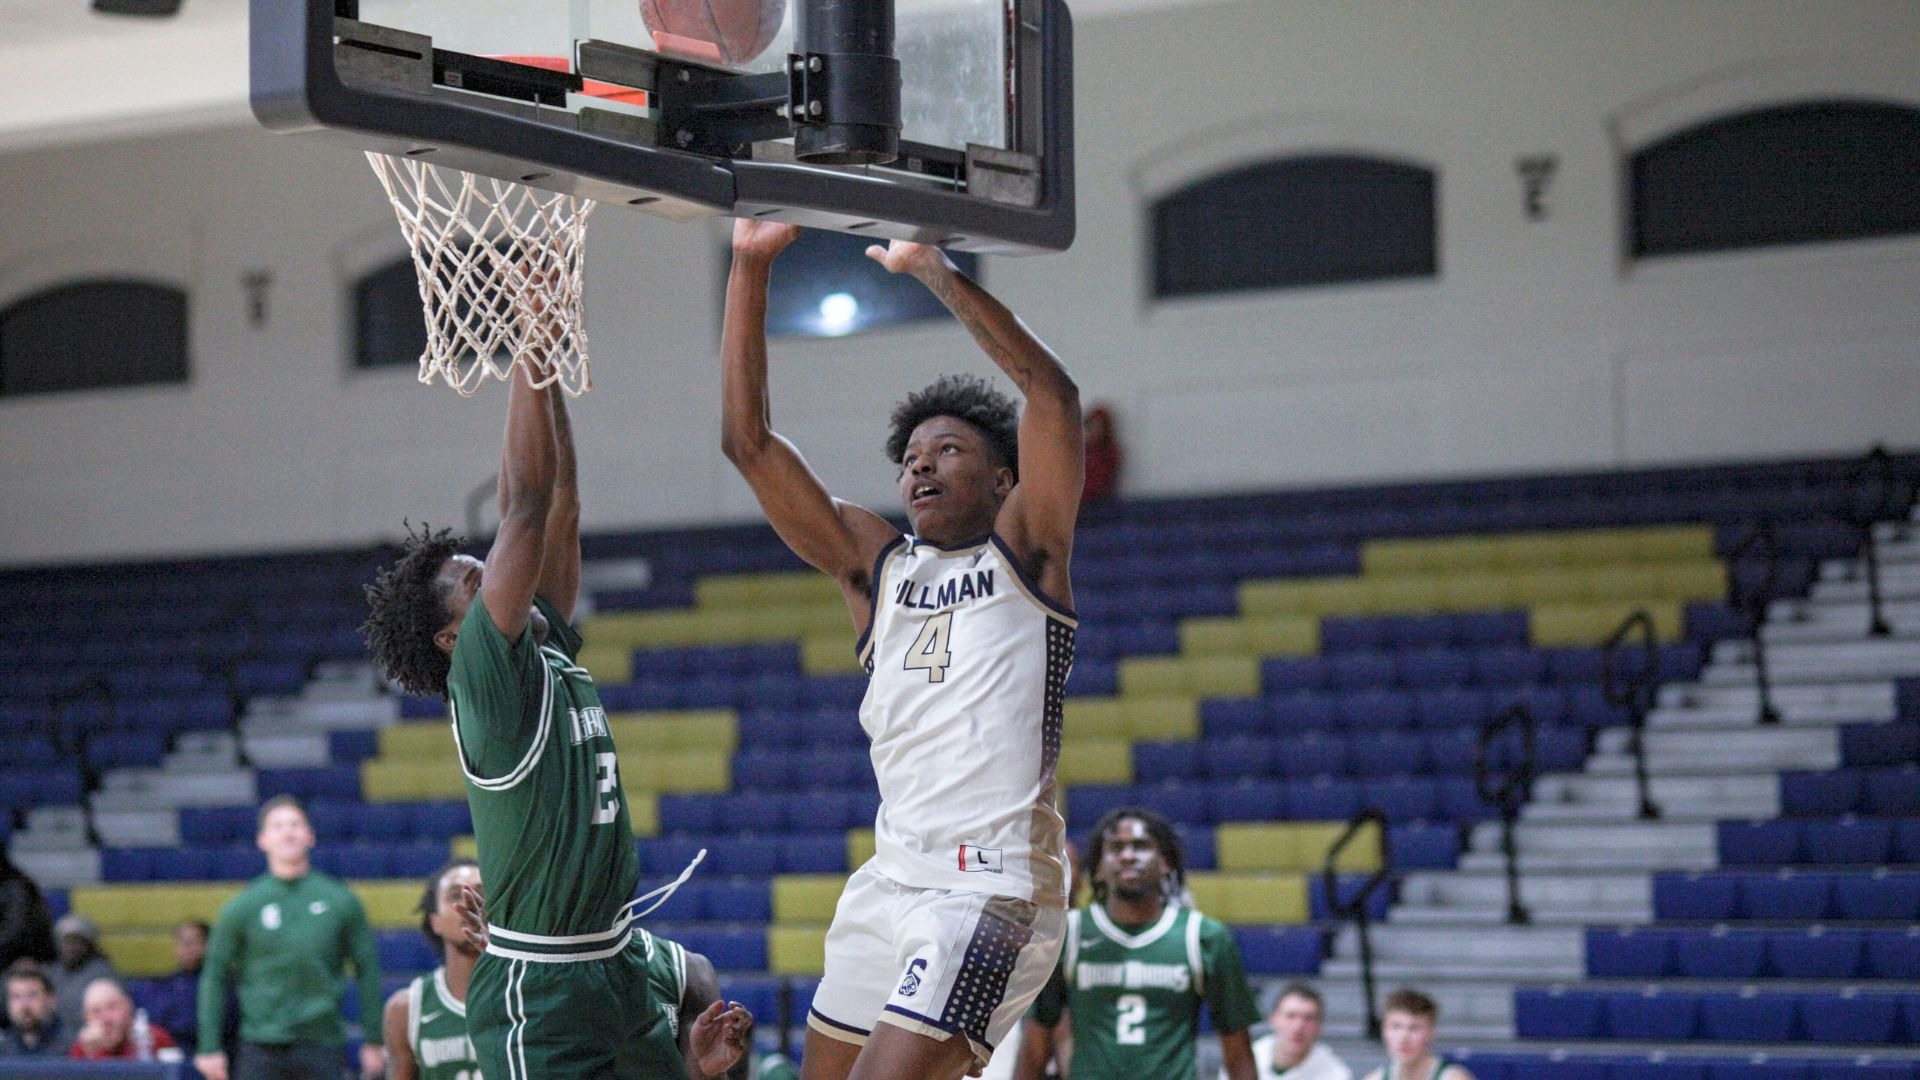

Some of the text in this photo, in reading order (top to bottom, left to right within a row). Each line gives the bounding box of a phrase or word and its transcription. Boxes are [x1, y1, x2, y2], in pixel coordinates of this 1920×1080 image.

[903, 611, 954, 684] 4
[591, 751, 620, 825] 2
[977, 850, 989, 865] L
[1116, 994, 1147, 1045] 2
